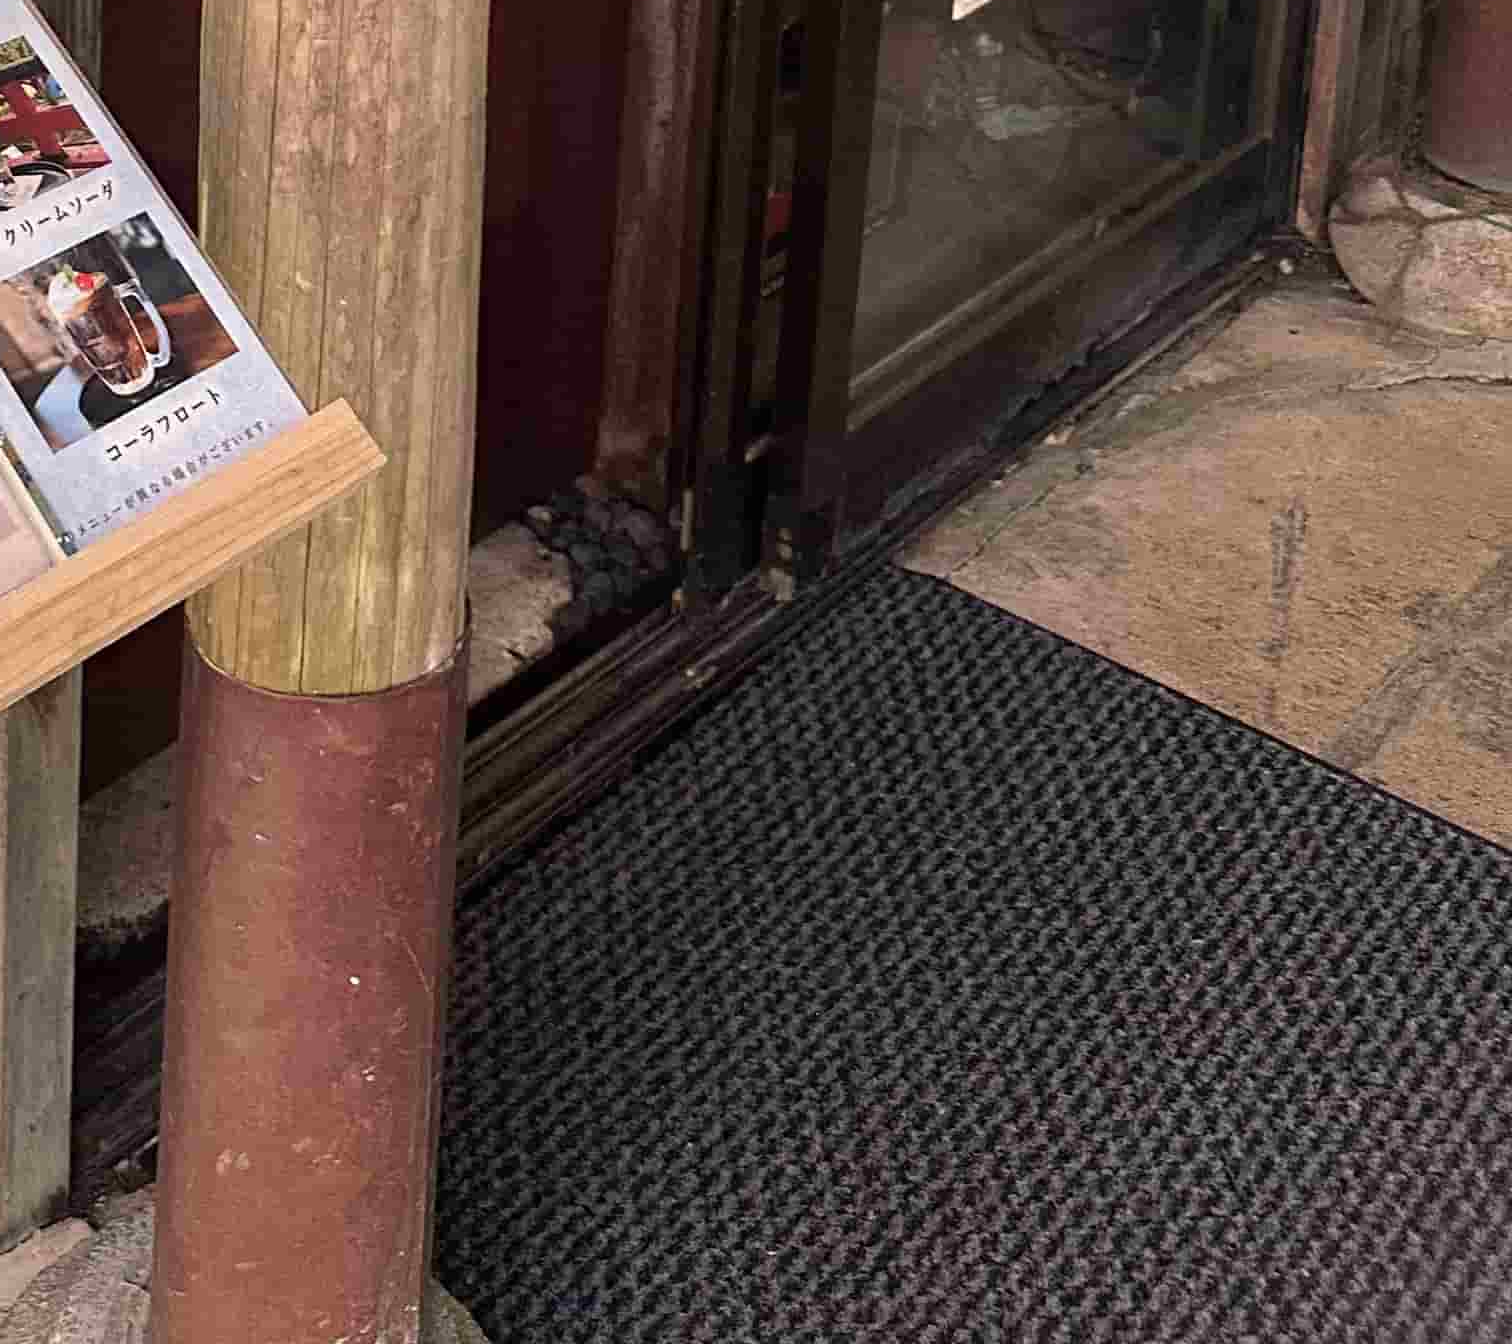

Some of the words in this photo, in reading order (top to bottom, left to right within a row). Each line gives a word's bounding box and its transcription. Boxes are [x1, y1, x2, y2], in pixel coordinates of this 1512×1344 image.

[106, 387, 223, 462] コーラフロート
